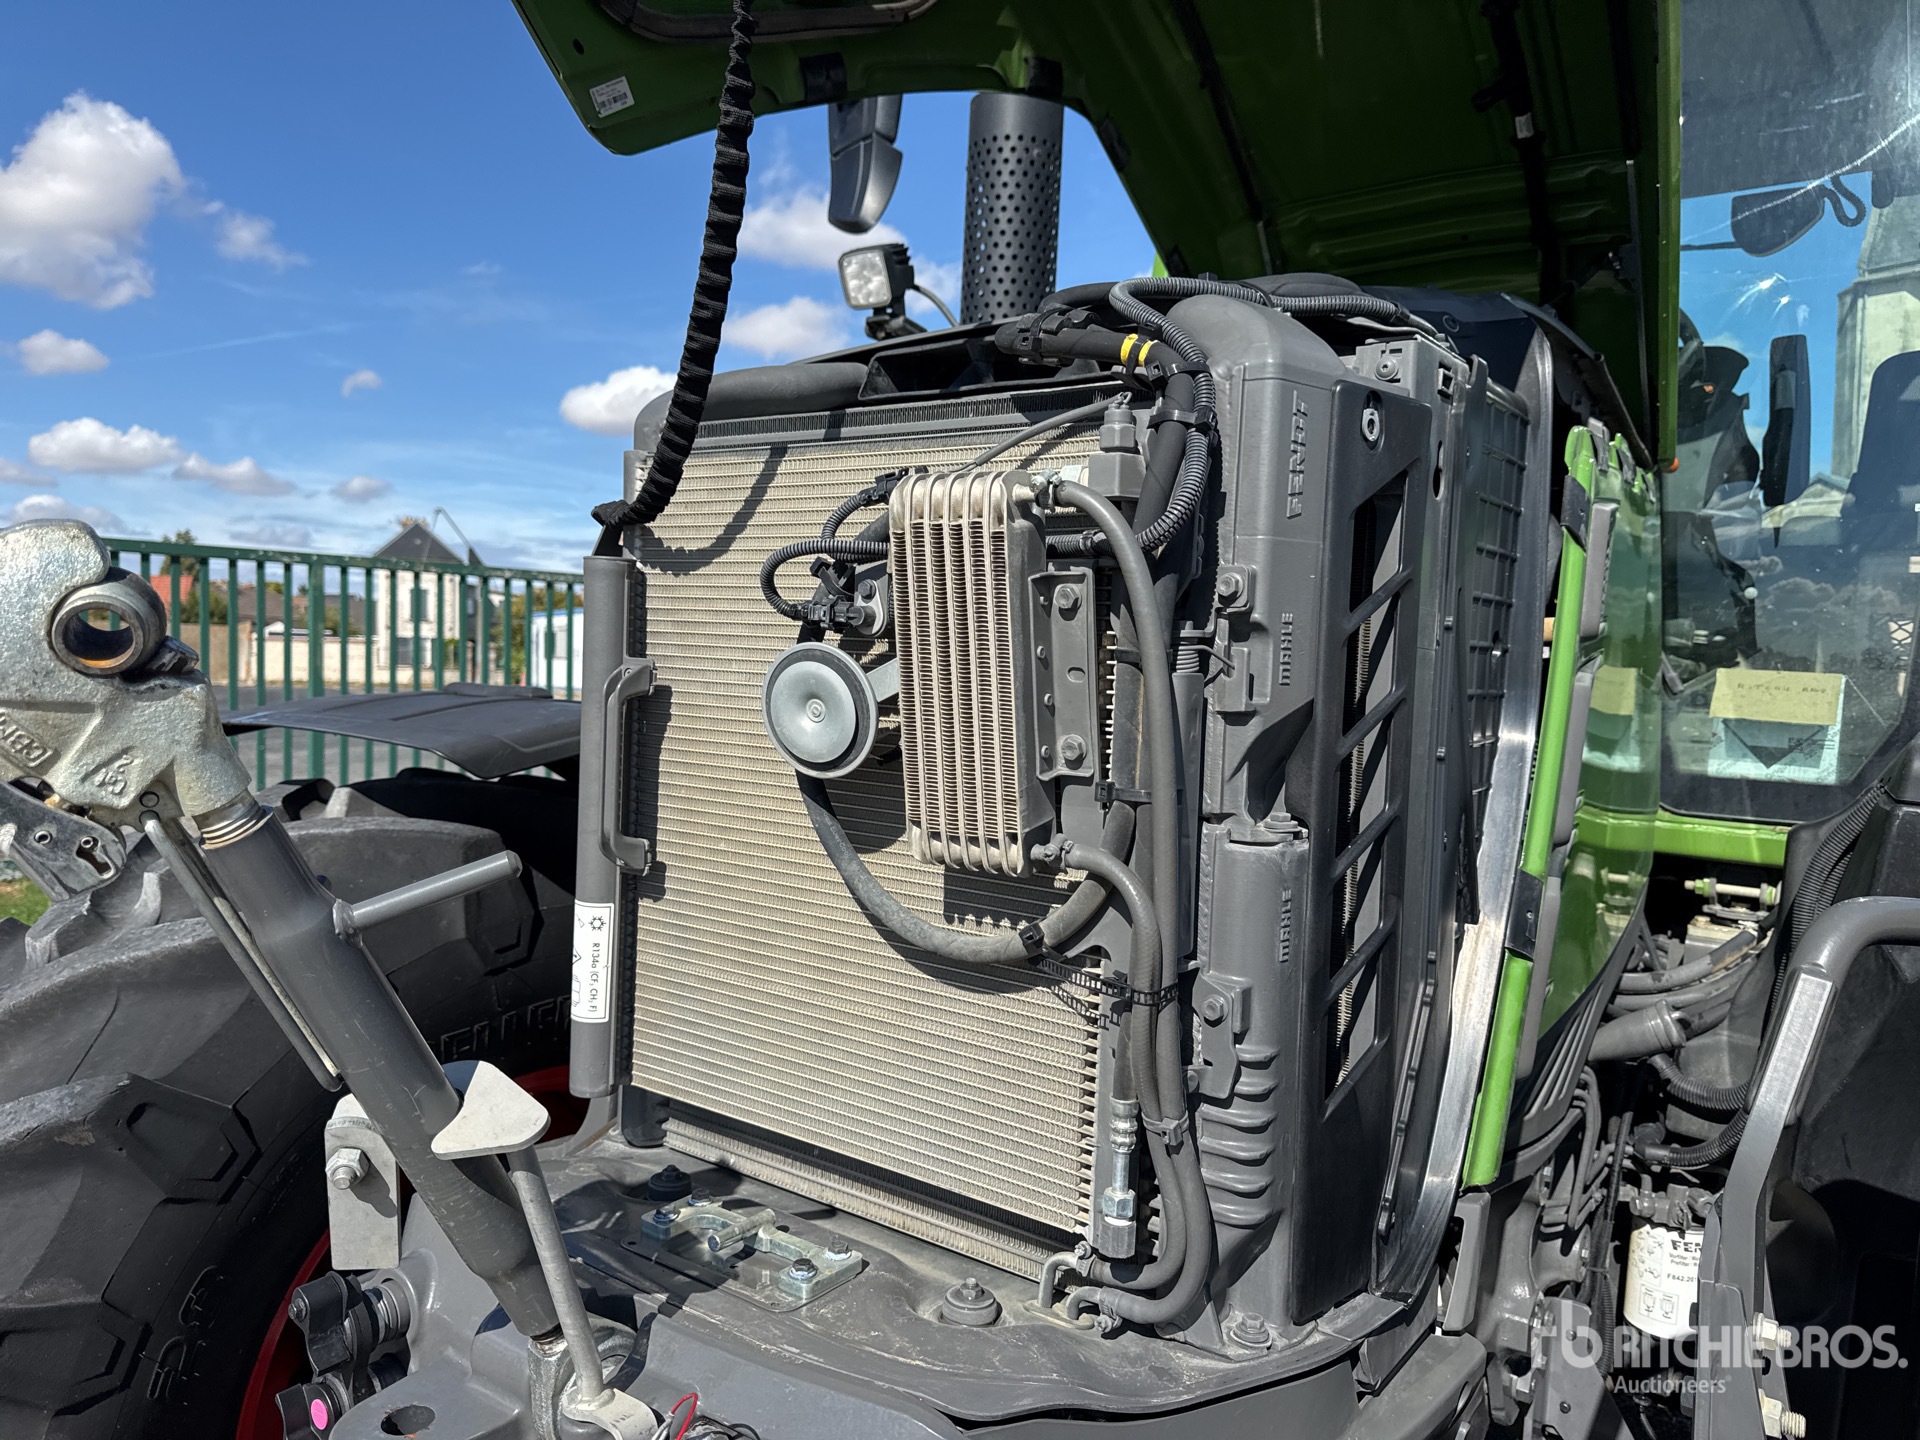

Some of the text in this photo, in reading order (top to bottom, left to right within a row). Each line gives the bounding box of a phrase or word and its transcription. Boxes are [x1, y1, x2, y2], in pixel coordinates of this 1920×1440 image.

[1287, 389, 1309, 520] FENDT
[1279, 612, 1293, 687] MAHLE
[591, 943, 600, 968] R134a
[1279, 888, 1292, 963] MAHLE
